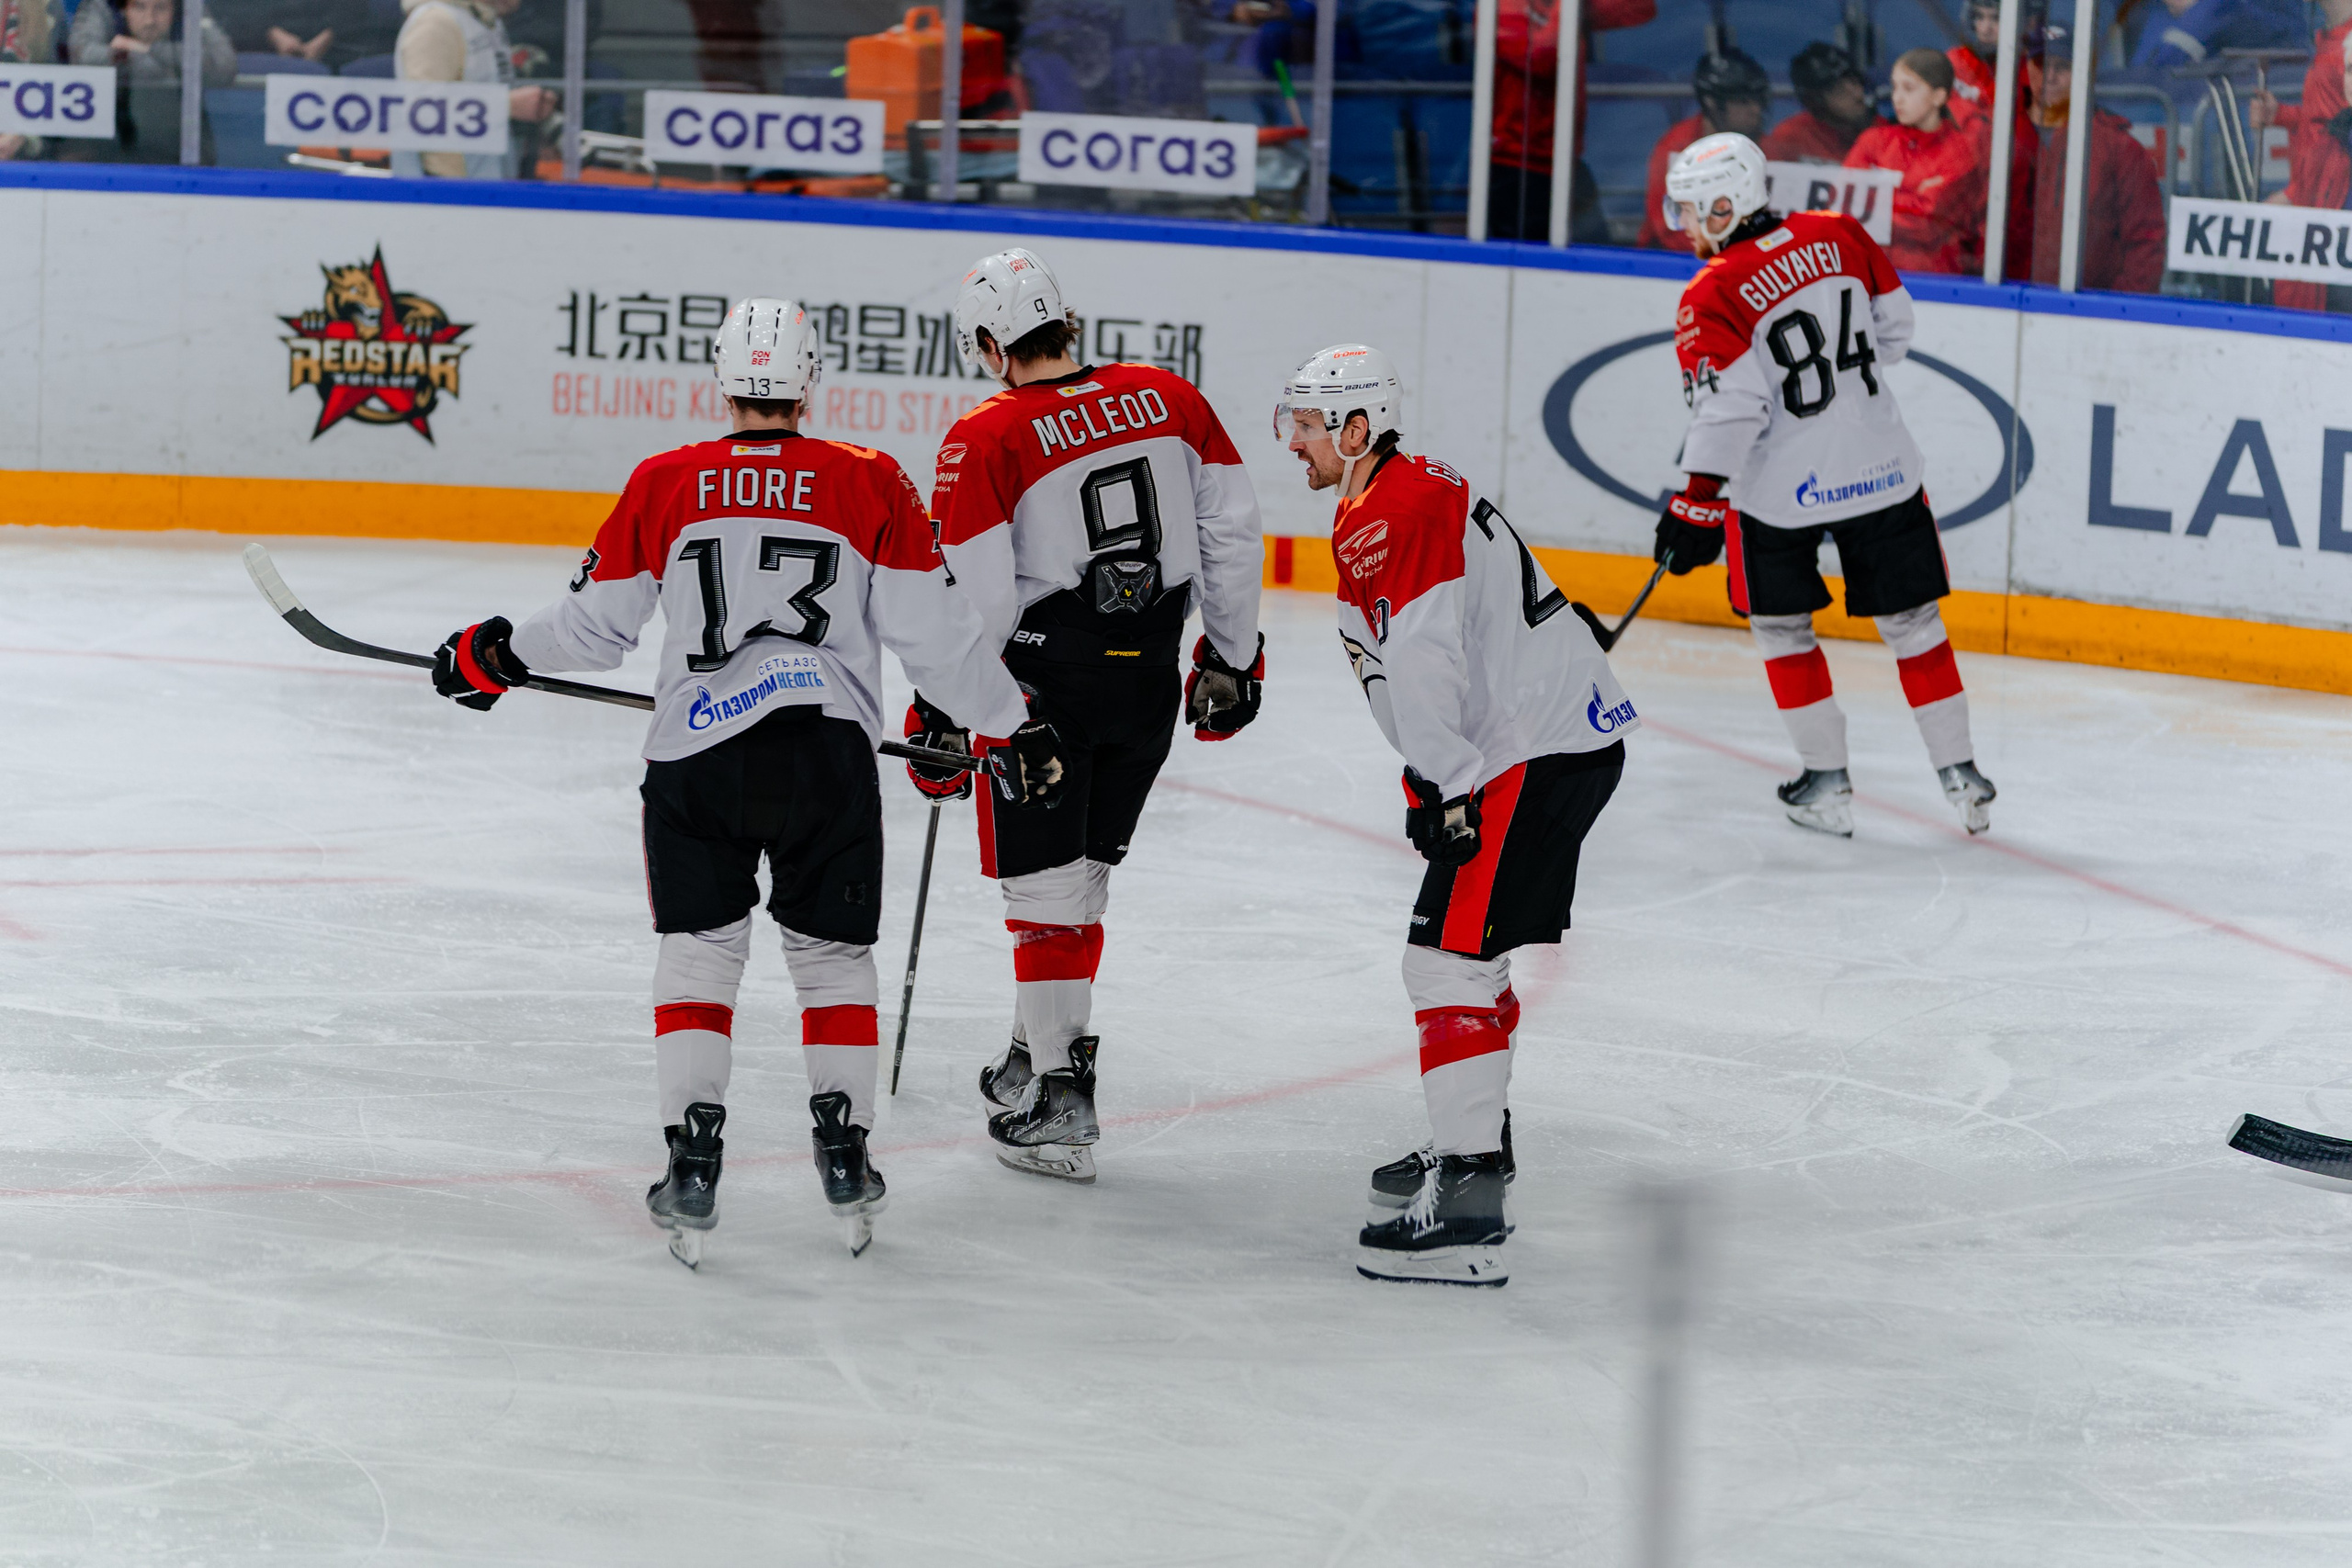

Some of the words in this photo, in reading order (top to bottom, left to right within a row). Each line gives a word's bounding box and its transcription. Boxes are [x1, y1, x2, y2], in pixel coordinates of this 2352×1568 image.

[1010, 258, 1025, 266] FON
[1014, 263, 1029, 272] BET
[1738, 241, 1843, 312] GULYAYEV
[1034, 298, 1048, 320] 9
[752, 350, 771, 358] FON
[1766, 288, 1879, 419] 84
[553, 371, 675, 421] BEIJING
[827, 386, 886, 432] RED
[748, 377, 770, 397] 13
[1031, 389, 1170, 457] MCLEOD
[697, 467, 817, 512] FIORE
[937, 472, 960, 483] RIVE
[1080, 456, 1163, 557] 9
[1670, 498, 1725, 523] CCM
[570, 543, 601, 594] 3
[676, 536, 841, 672] 13
[758, 658, 789, 674] СЕТЬ
[794, 656, 818, 669] АЗС
[714, 671, 826, 722] ГАЗПРОМНЕФТЬ
[1014, 1118, 1042, 1138] BAUER
